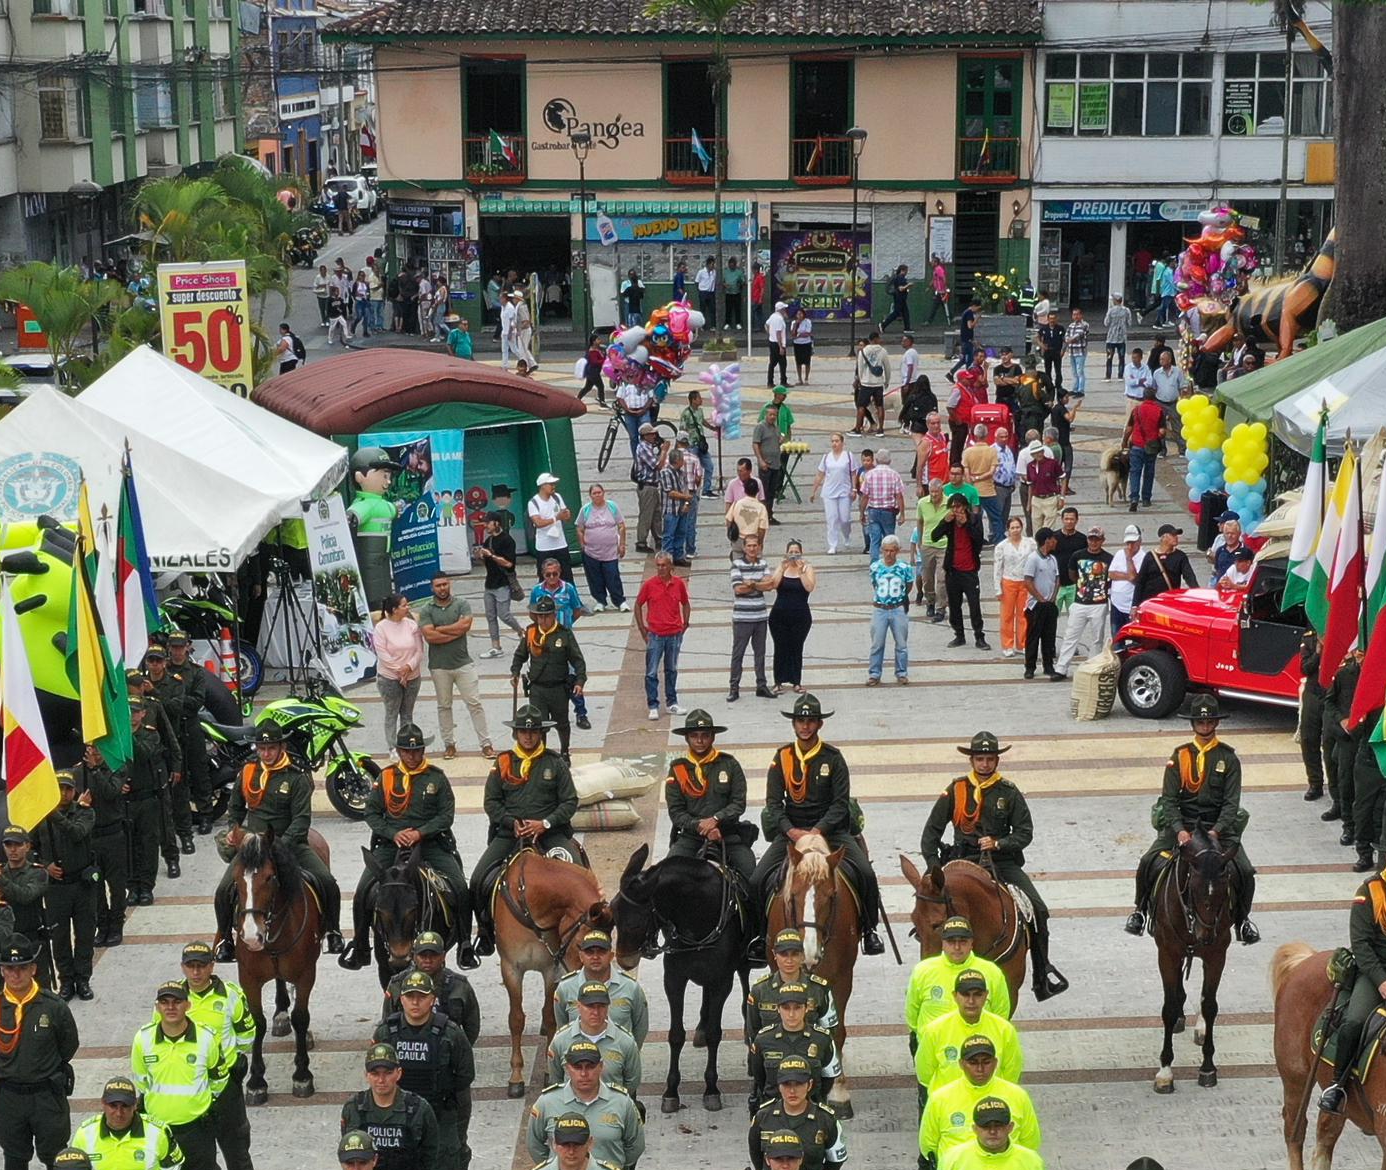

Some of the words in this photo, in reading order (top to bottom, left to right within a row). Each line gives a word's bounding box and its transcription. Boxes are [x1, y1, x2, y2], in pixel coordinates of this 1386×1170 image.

[566, 114, 644, 149] Pangea
[531, 141, 570, 150] Gastrobar
[1071, 202, 1151, 215] PREDILECTA
[632, 218, 680, 239] NUEVO
[682, 219, 719, 240] IRIS
[175, 276, 199, 287] Price
[201, 274, 230, 285] Shoes
[172, 292, 194, 304] super
[196, 289, 237, 302] descuento
[801, 297, 841, 309] SPIN
[1215, 662, 1235, 672] Jeep
[944, 921, 968, 930] POLICIA
[583, 932, 608, 941] POLICIA
[776, 933, 801, 942] POLICIA
[959, 972, 984, 982] POLICIA
[582, 984, 607, 994] POLICIA
[779, 984, 804, 993] POLICIA
[396, 1041, 429, 1052] POLICIA
[571, 1042, 598, 1052] POLICIA
[964, 1038, 990, 1047] POLICIA
[398, 1052, 426, 1061] GAULA
[780, 1060, 806, 1070] POLICIA
[976, 1101, 1006, 1111] POLICIA
[557, 1118, 586, 1129] POLICIA
[367, 1126, 403, 1138] POLICIA
[770, 1135, 800, 1144] POLICIA
[55, 1152, 85, 1162] POLICIA
